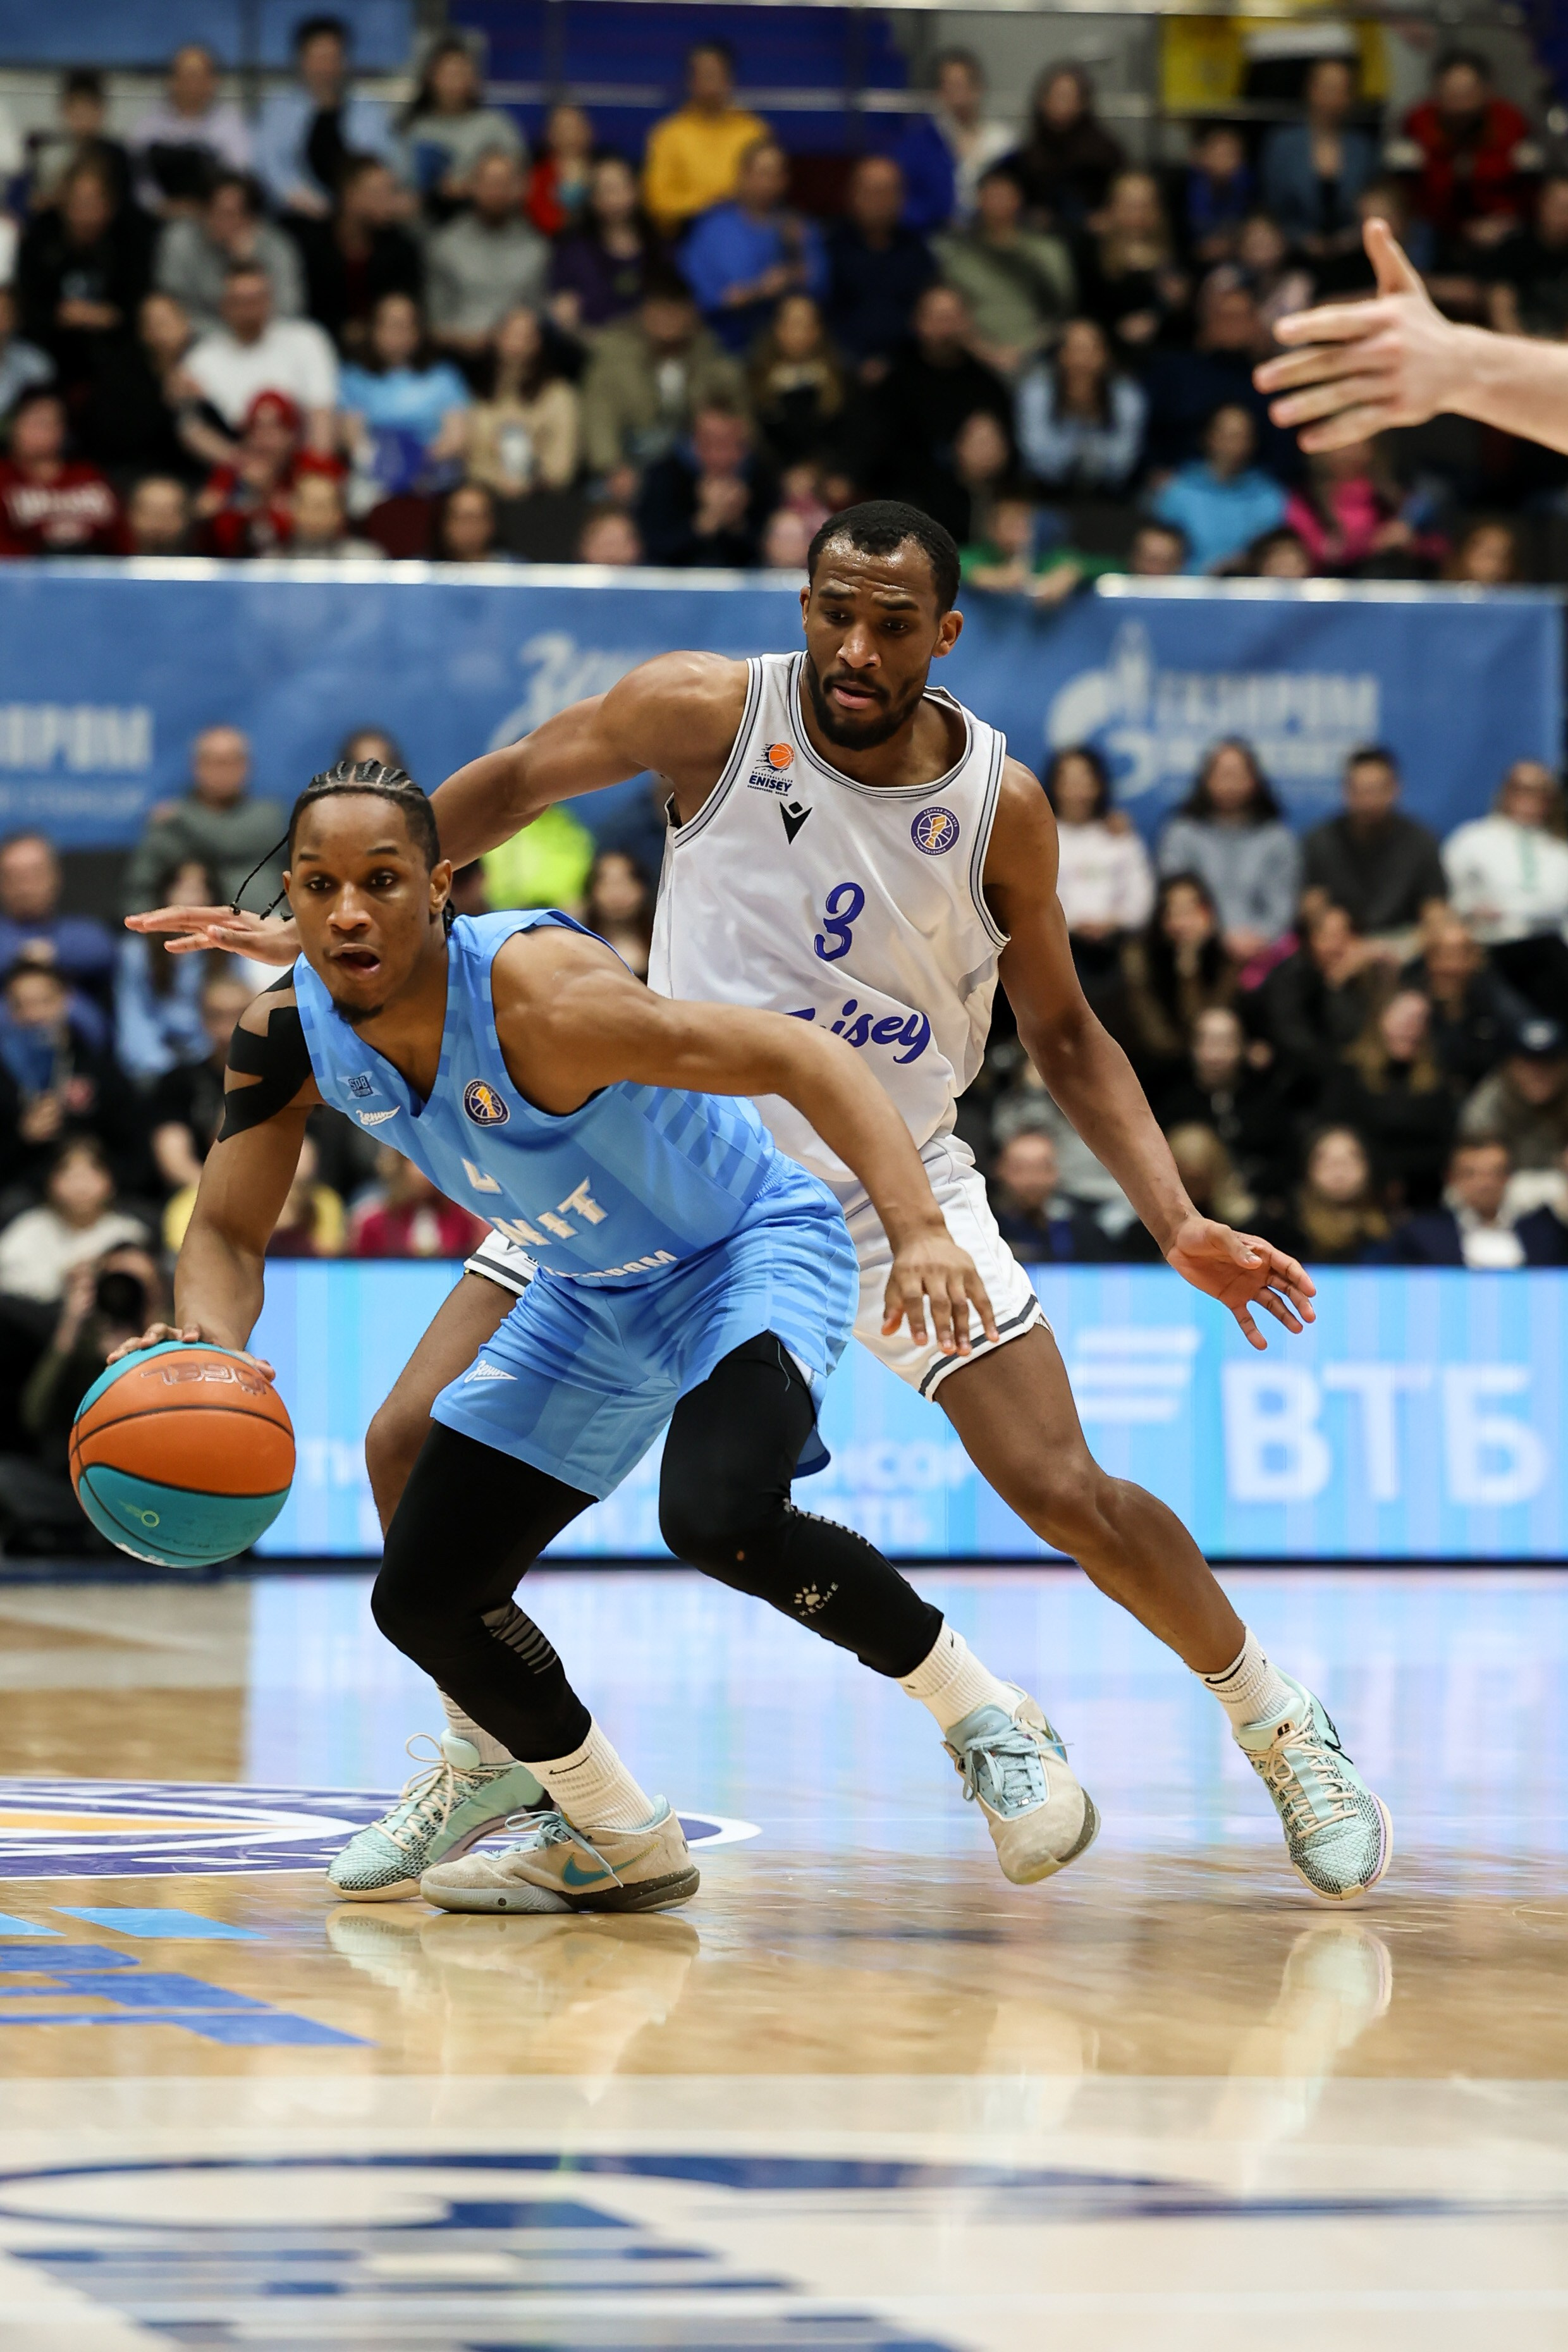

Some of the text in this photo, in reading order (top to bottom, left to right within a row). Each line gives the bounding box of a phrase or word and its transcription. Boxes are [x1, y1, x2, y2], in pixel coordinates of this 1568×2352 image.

[749, 775, 792, 792] ENISEY
[814, 882, 865, 962] 3
[783, 998, 931, 1065] isey
[1222, 1359, 1549, 1506] ВТБ
